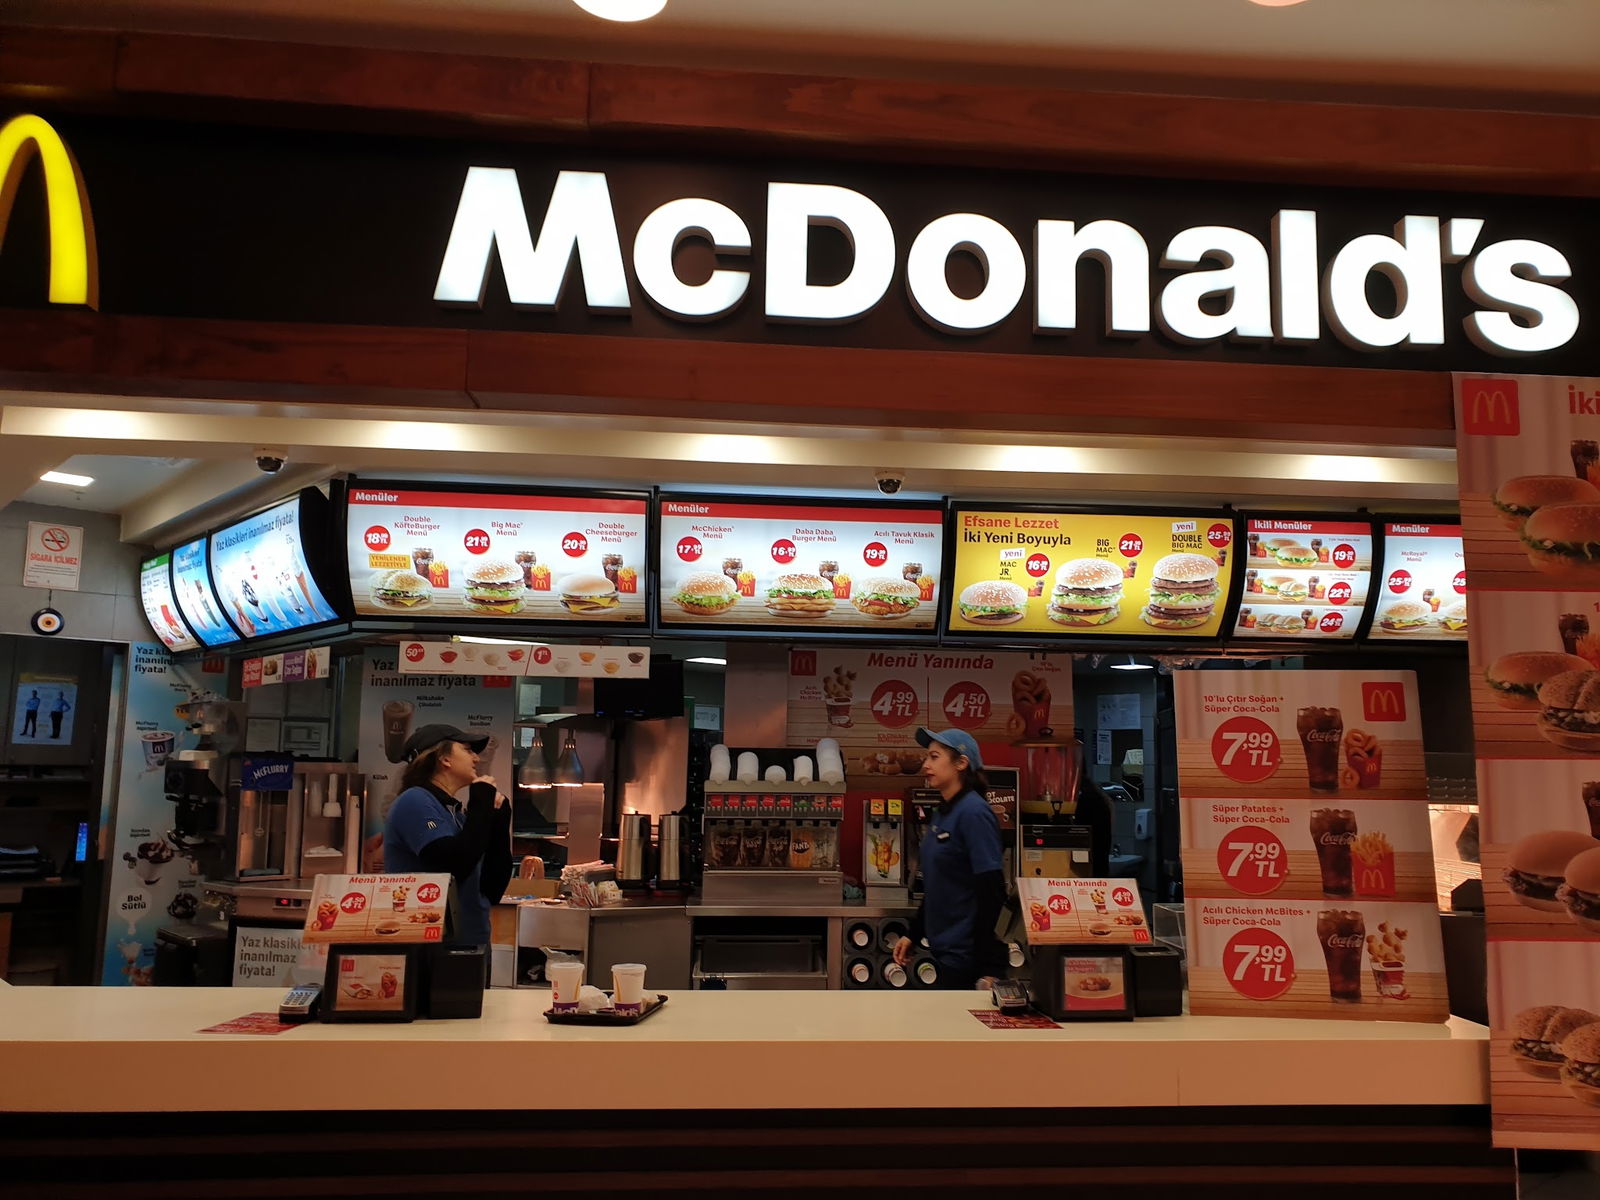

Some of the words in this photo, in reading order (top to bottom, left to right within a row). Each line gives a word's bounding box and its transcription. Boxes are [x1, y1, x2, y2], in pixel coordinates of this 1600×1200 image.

[433, 166, 1580, 353] McDonald's
[355, 492, 398, 503] Menüler
[668, 504, 709, 514] Menüler
[492, 521, 504, 531] Big
[964, 516, 1011, 528] Efsane
[1014, 517, 1060, 529] Lezzet
[1176, 523, 1193, 533] yeni
[1274, 521, 1312, 531] Menüler
[407, 529, 428, 537] Menü
[585, 529, 638, 538] Cheeseburger
[1392, 525, 1430, 533] Menüler
[792, 535, 816, 543] Burger
[964, 528, 981, 543] İki
[985, 532, 1013, 543] Yeni
[1017, 533, 1071, 547] Boyuyla
[1096, 539, 1109, 547] BIG
[1005, 550, 1022, 558] yeni
[136, 646, 154, 655] Yaz
[373, 659, 395, 671] Yaz
[867, 652, 917, 668] Menü
[924, 653, 994, 670] Yanında
[135, 664, 166, 674] fiyata!
[371, 674, 435, 687] inanılmaz
[438, 675, 477, 690] fiyata
[944, 692, 987, 718] 4,50
[1204, 695, 1225, 703] 10'lu
[1227, 696, 1246, 705] Çıtır
[1248, 695, 1277, 706] Soğan
[896, 704, 913, 716] TL
[968, 705, 986, 718] TL
[1204, 704, 1230, 715] Süper
[1233, 705, 1281, 713] Coca-Cola
[1222, 732, 1273, 767] 7,99
[1249, 749, 1273, 767] TL
[1213, 804, 1239, 814] Süper
[1242, 805, 1277, 813] Patates
[1213, 815, 1239, 825] Süper
[1242, 816, 1290, 824] Coca-Cola
[1227, 842, 1280, 878] 7,99
[1257, 861, 1280, 878] TL
[349, 876, 377, 884] Menü
[379, 876, 417, 884] Yanında
[1074, 880, 1108, 888] Yanında
[127, 894, 142, 902] Bol
[122, 901, 146, 911] Sütlü
[1202, 906, 1223, 915] Acılı
[1225, 906, 1263, 915] Chicken
[1265, 908, 1304, 917] McBites
[1203, 917, 1229, 927] Süper
[1232, 918, 1281, 926] Coca-Cola
[242, 936, 262, 948] Yaz
[240, 949, 297, 964] inanılmaz
[1233, 945, 1287, 981] 7,99
[239, 963, 276, 979] fiyata!
[1263, 963, 1286, 982] TL
